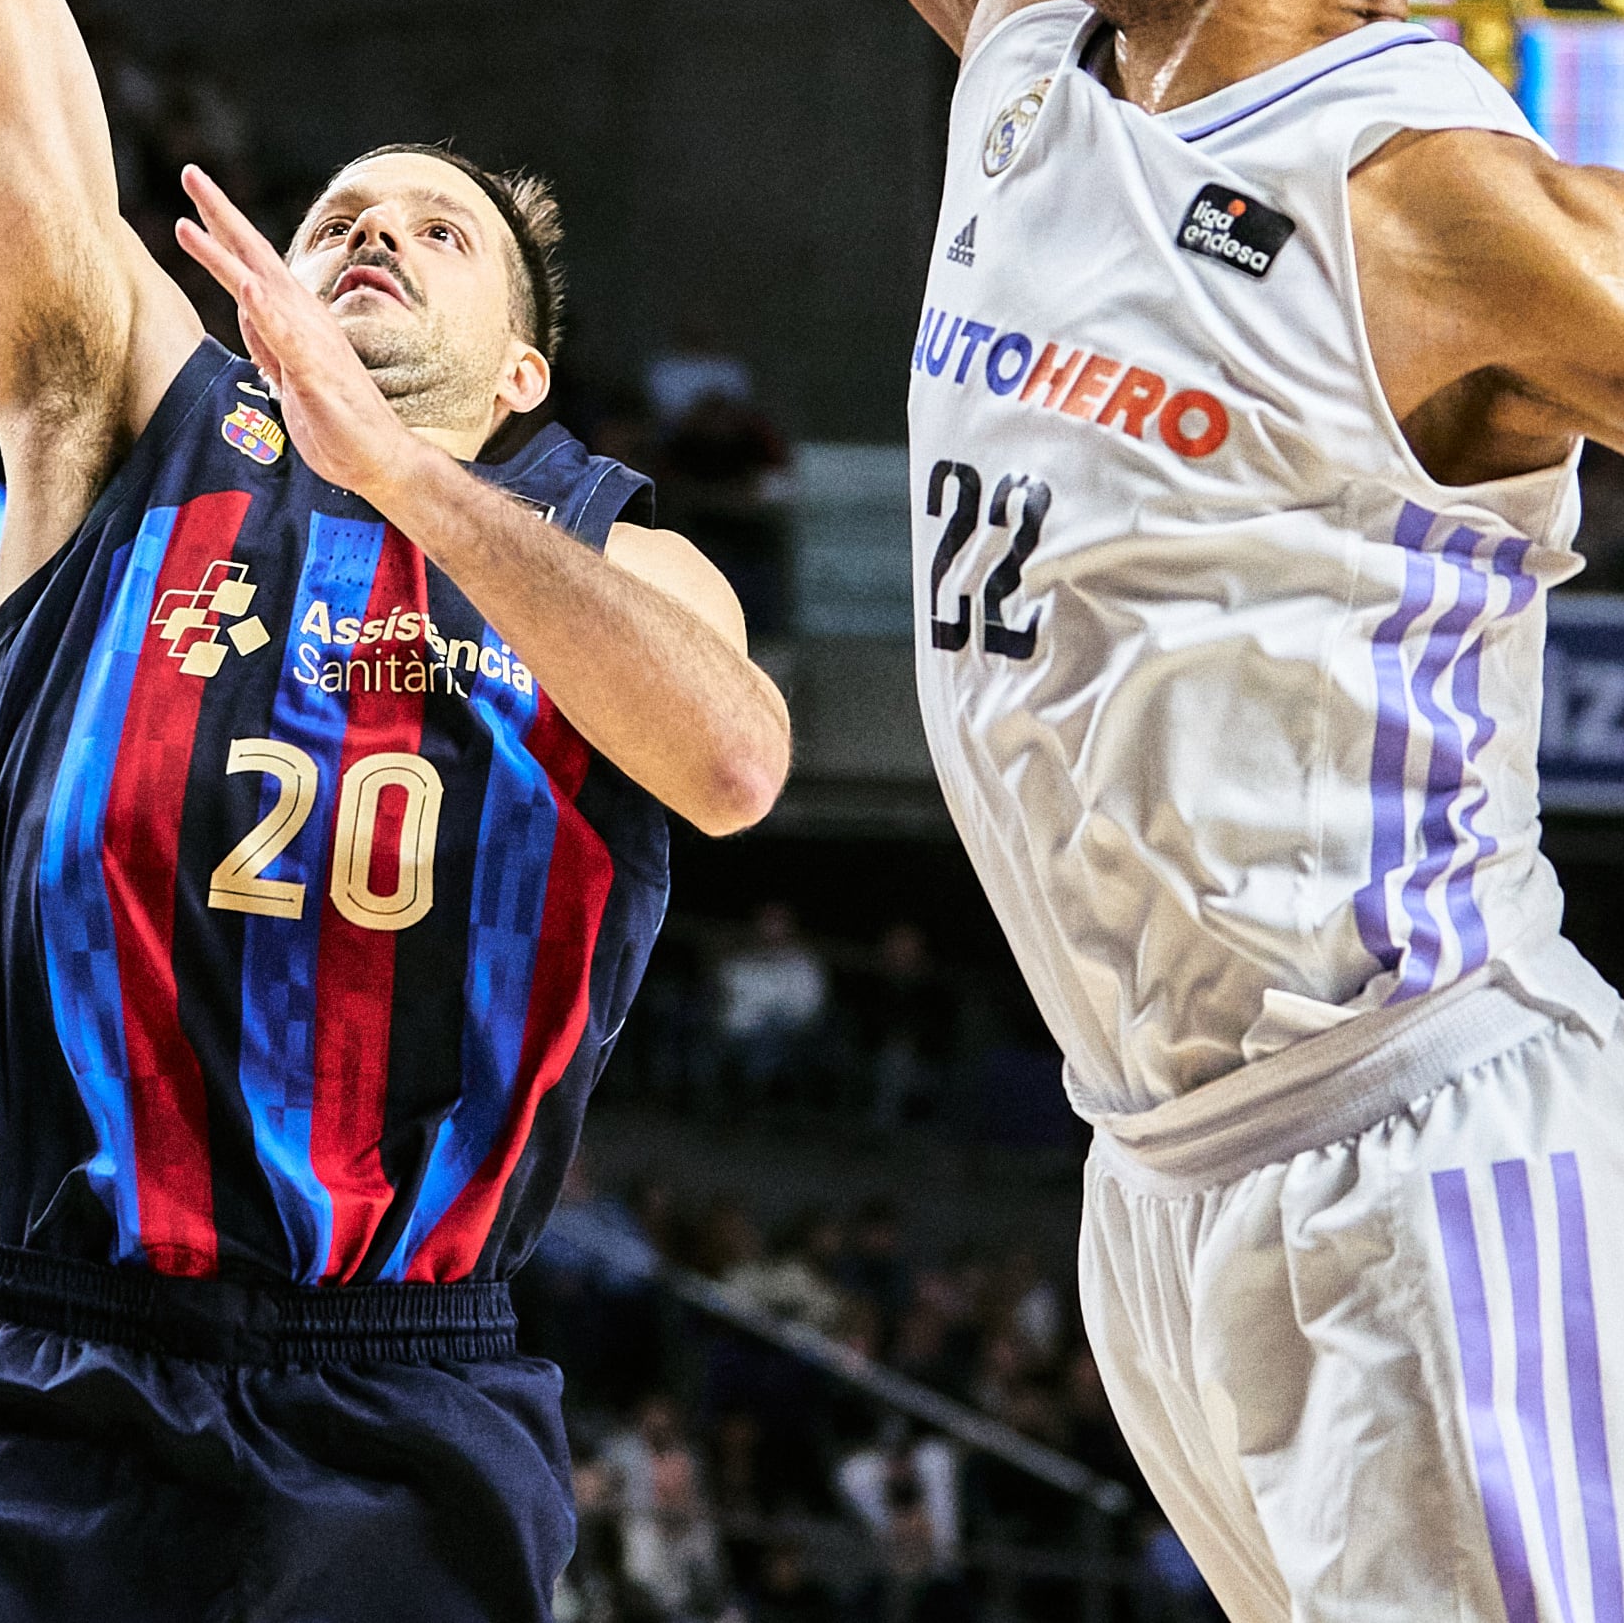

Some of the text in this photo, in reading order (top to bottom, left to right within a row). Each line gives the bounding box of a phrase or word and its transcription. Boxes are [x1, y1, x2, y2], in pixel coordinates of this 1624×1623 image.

[1183, 224, 1270, 273] endesa
[1192, 199, 1235, 230] liga
[926, 459, 1052, 661] 22
[207, 737, 445, 932] 20
